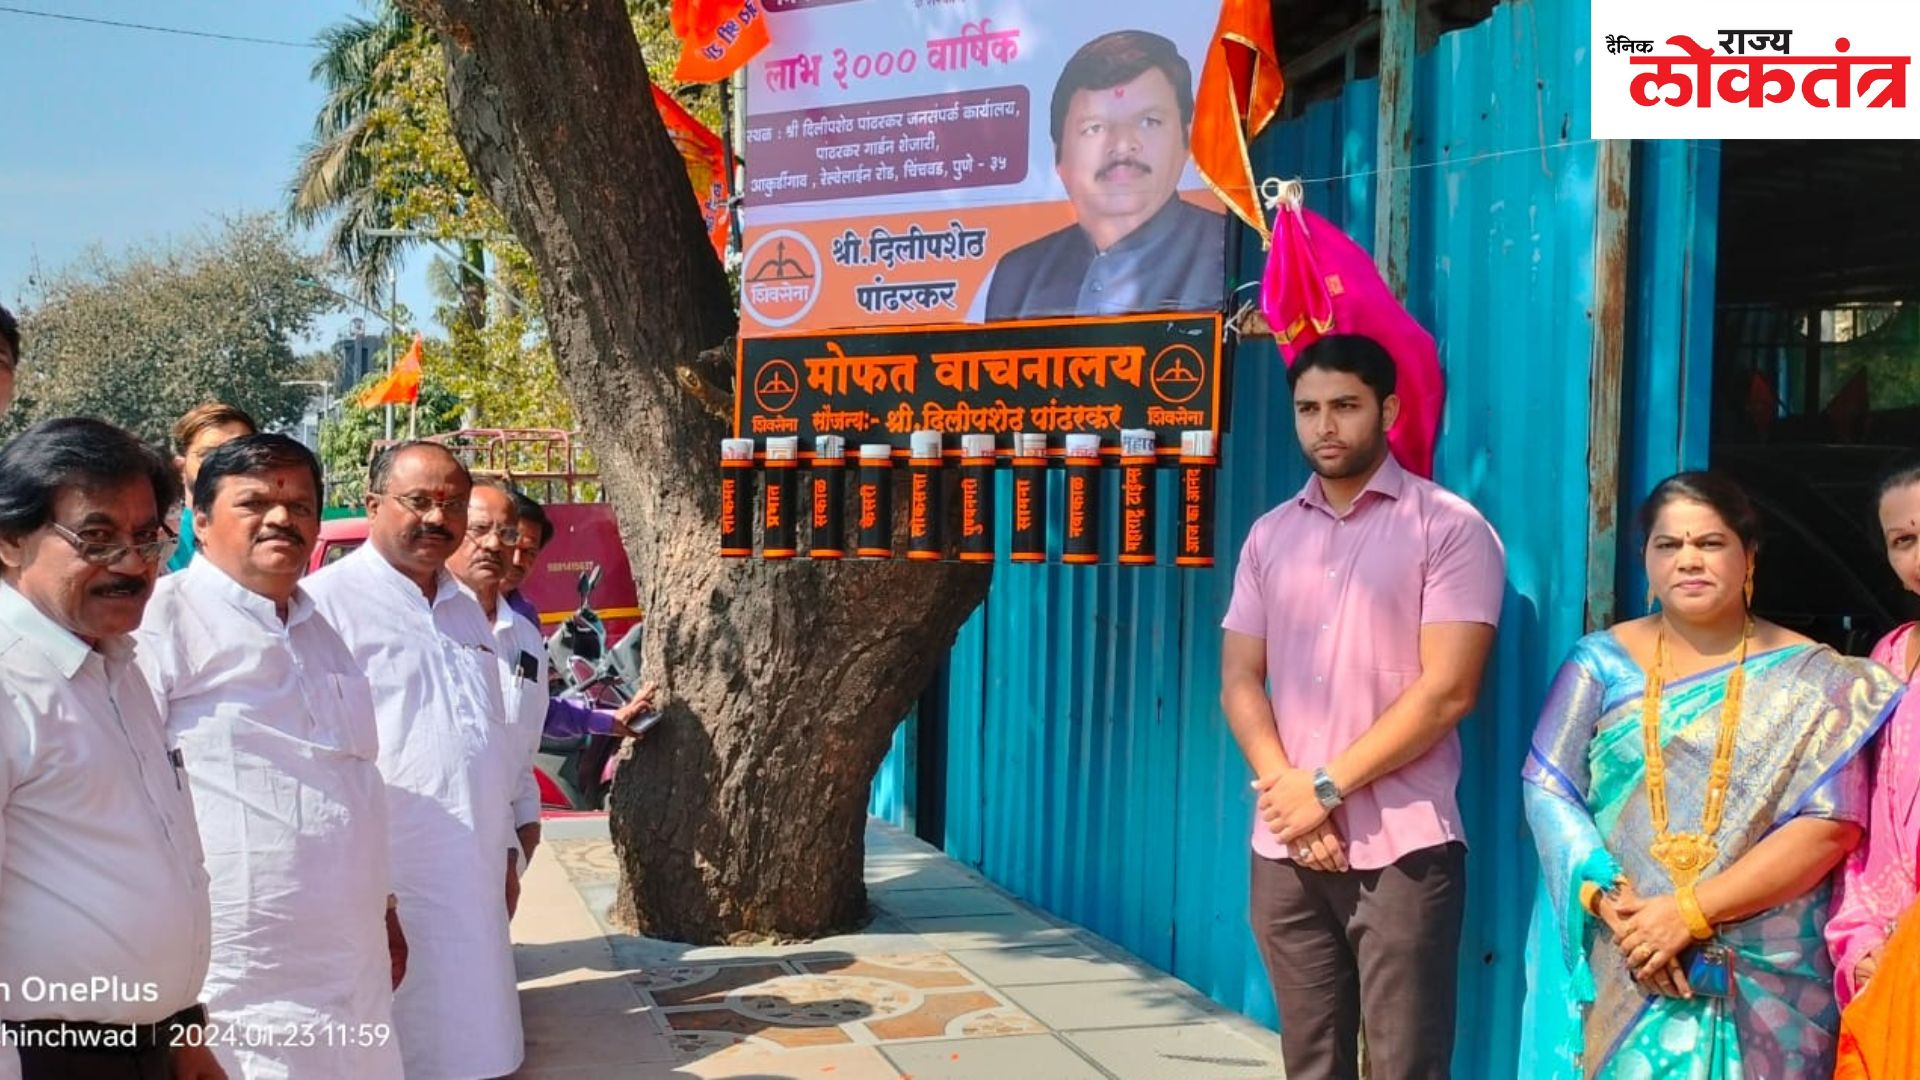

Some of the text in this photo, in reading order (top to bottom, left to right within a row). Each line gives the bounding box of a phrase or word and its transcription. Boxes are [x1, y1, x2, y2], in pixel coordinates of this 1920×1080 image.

[764, 18, 1020, 92] लाभ ३००० वार्षिक
[785, 118, 799, 139] श्री
[803, 115, 854, 138] दिलीपशेठ
[907, 104, 959, 126] जनसंपर्क
[962, 98, 1021, 121] कार्यालय,
[899, 131, 940, 153] शेजारी,
[876, 161, 899, 183] रोड,
[953, 154, 973, 181] पुणे
[989, 156, 1008, 172] ३५
[832, 220, 986, 267] श्री.दिलीपशेठ
[751, 283, 810, 306] शिवसेना
[857, 276, 956, 312] पांढरकर
[803, 341, 1146, 395] मोफत वाचनालय
[752, 415, 798, 433] शिवसेना
[1030, 400, 1122, 431] पांढरकर
[1147, 405, 1204, 427] शिवसेना
[766, 484, 781, 529] प्रभात
[814, 478, 829, 529] सकाळ
[1016, 478, 1032, 533] सामना
[1069, 475, 1084, 539] नवाकाळ
[1186, 505, 1200, 523] का
[1186, 524, 1200, 553] आज
